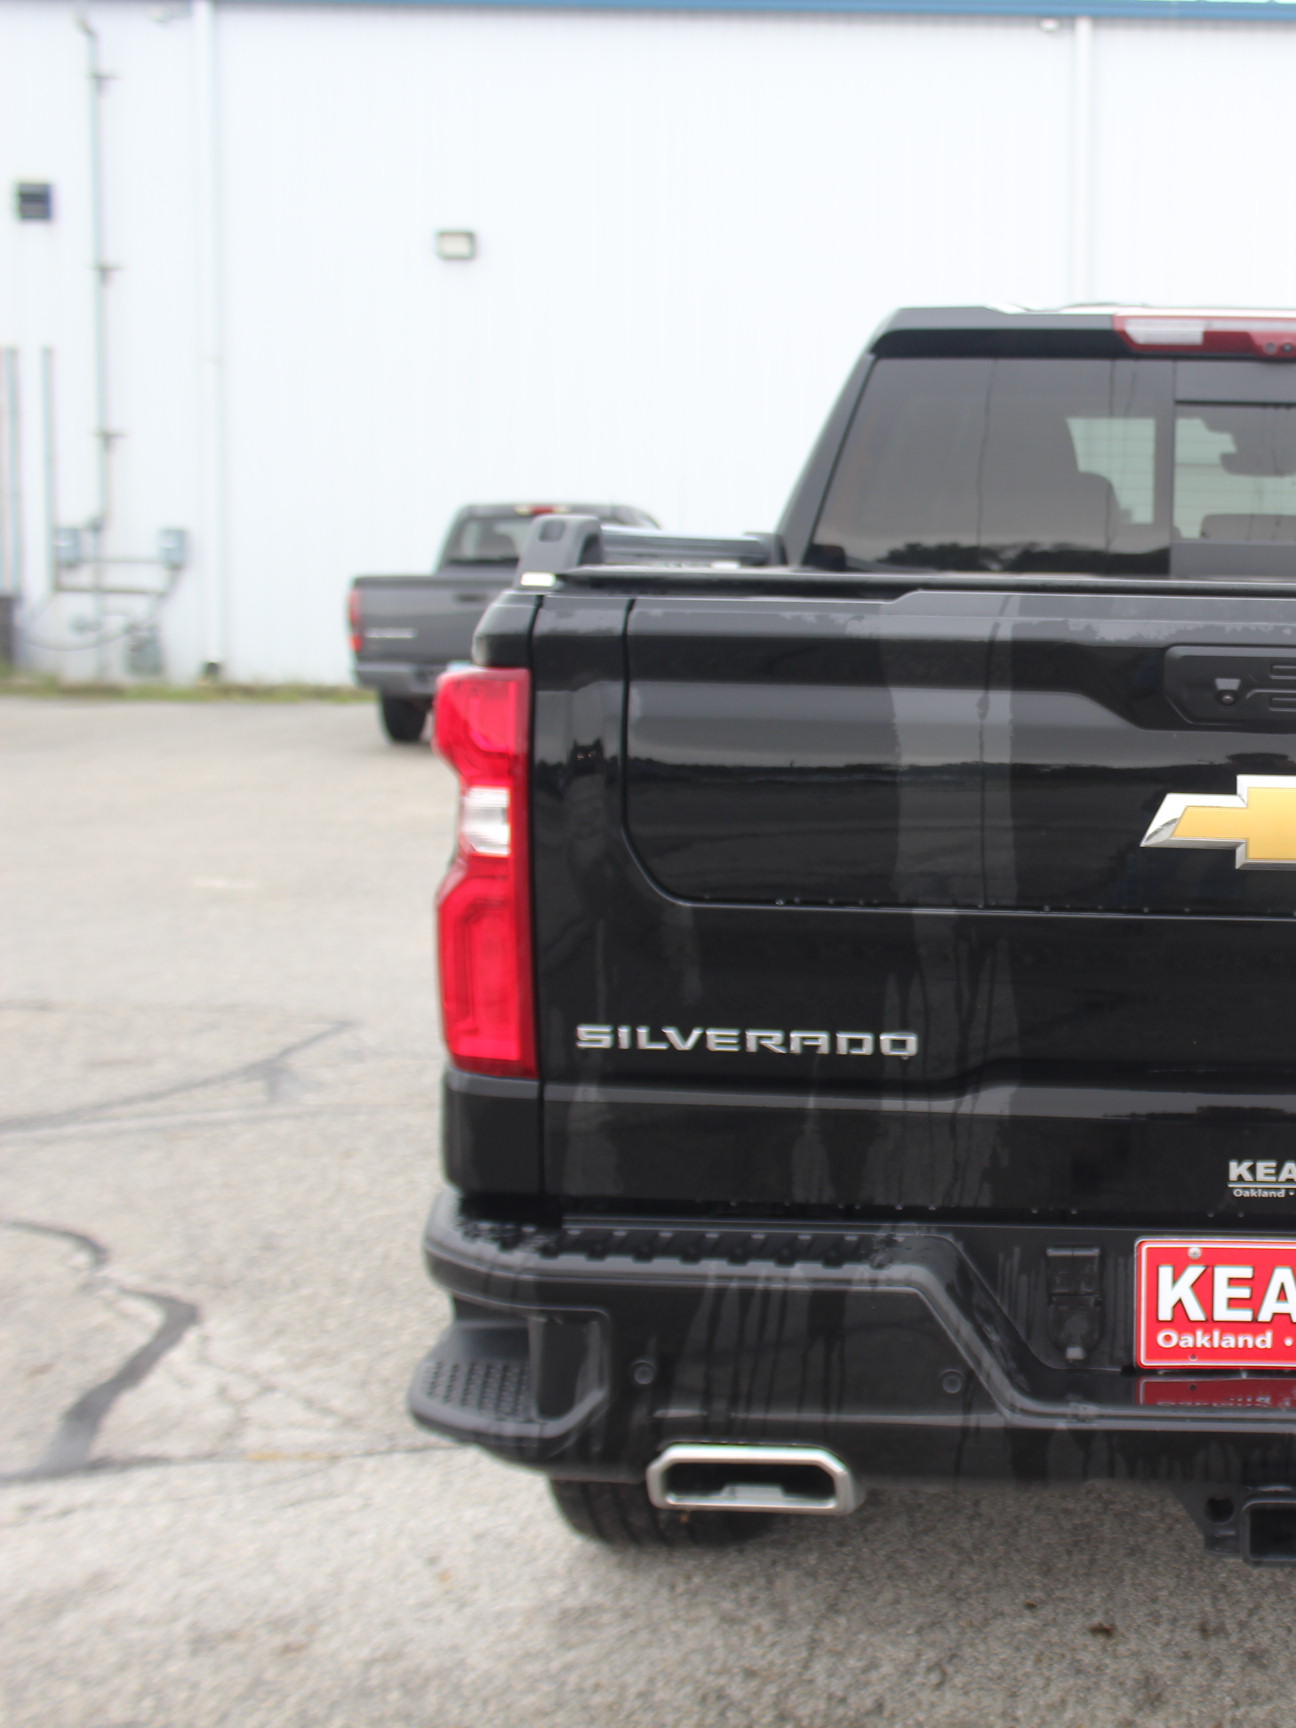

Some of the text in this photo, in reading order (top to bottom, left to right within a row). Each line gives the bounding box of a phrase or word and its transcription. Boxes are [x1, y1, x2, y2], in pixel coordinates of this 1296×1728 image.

[576, 1023, 918, 1056] SILVERADO
[1232, 1188, 1286, 1199] Oakland
[1156, 1329, 1273, 1350] Oakland
